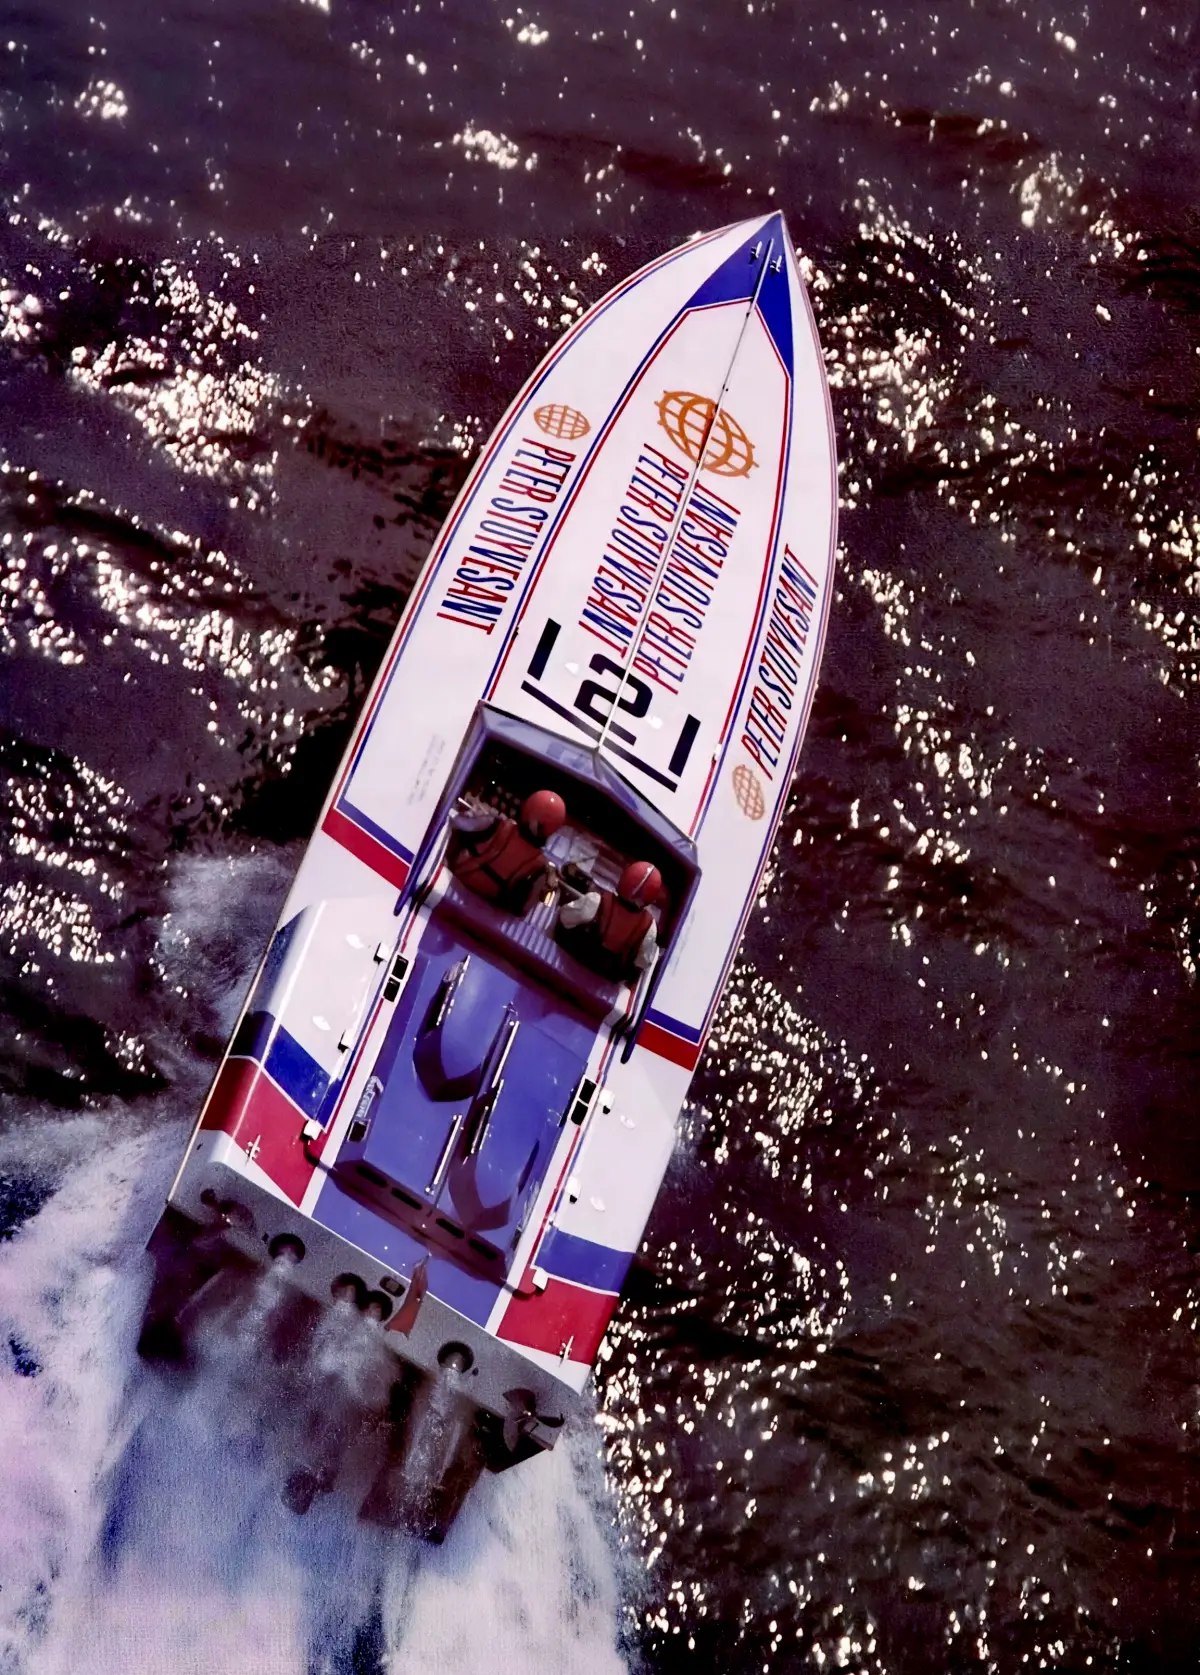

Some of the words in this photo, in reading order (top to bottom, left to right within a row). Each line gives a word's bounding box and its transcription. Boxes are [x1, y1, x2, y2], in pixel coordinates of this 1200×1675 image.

[499, 438, 577, 503] PETER
[626, 443, 689, 522] PETER
[436, 497, 549, 635] STUYVESANT
[578, 505, 668, 659] STUYVESANT
[655, 479, 741, 629] STUYVESANT
[632, 611, 697, 695] PETER
[758, 543, 819, 710] STUYVESANT
[741, 685, 788, 781] PETER
